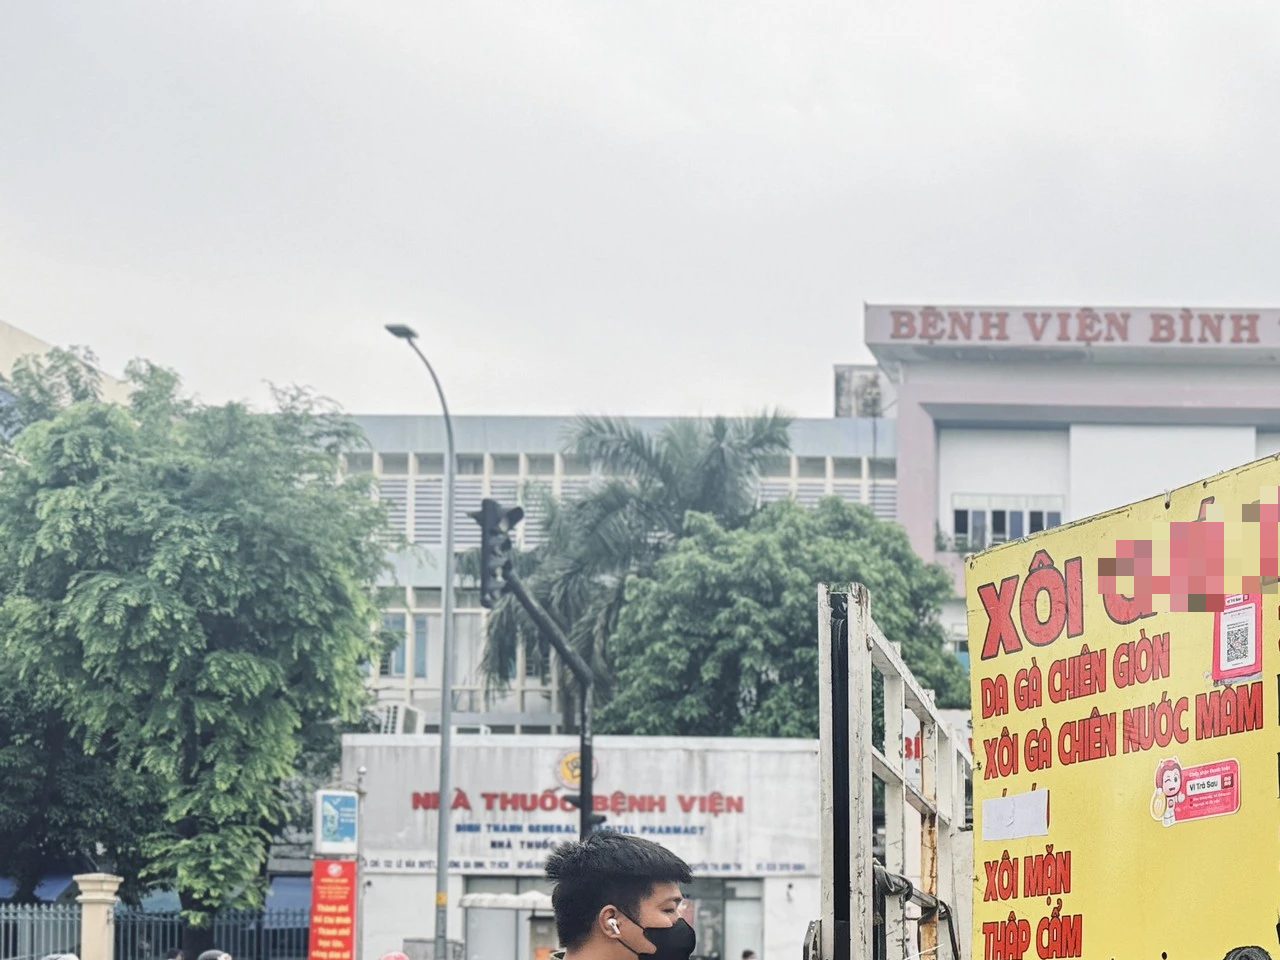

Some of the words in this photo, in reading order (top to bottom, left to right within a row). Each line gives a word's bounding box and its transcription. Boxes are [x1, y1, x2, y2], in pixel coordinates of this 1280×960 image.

[890, 306, 1010, 345] BỆNH
[1023, 307, 1131, 347] VIỆN
[1150, 308, 1261, 344] BÌNH
[977, 549, 1084, 660] XÔI
[981, 673, 1009, 719] DA
[1014, 657, 1042, 711] GÀ
[1048, 644, 1106, 703] CHIÊN
[1113, 628, 1170, 689] GIÒN
[983, 727, 1019, 780] XÔI
[1024, 718, 1052, 772] GÀ
[1058, 707, 1117, 766] CHIÊN
[1122, 692, 1190, 754] NƯỚC
[528, 824, 577, 833] GENERAL
[641, 825, 706, 835] PHARMACY
[591, 790, 666, 817] BỆNH
[678, 790, 745, 818] VIỆN
[984, 850, 1019, 901] XÔI
[1023, 844, 1072, 906] MẶN
[1035, 898, 1083, 960] CẨM
